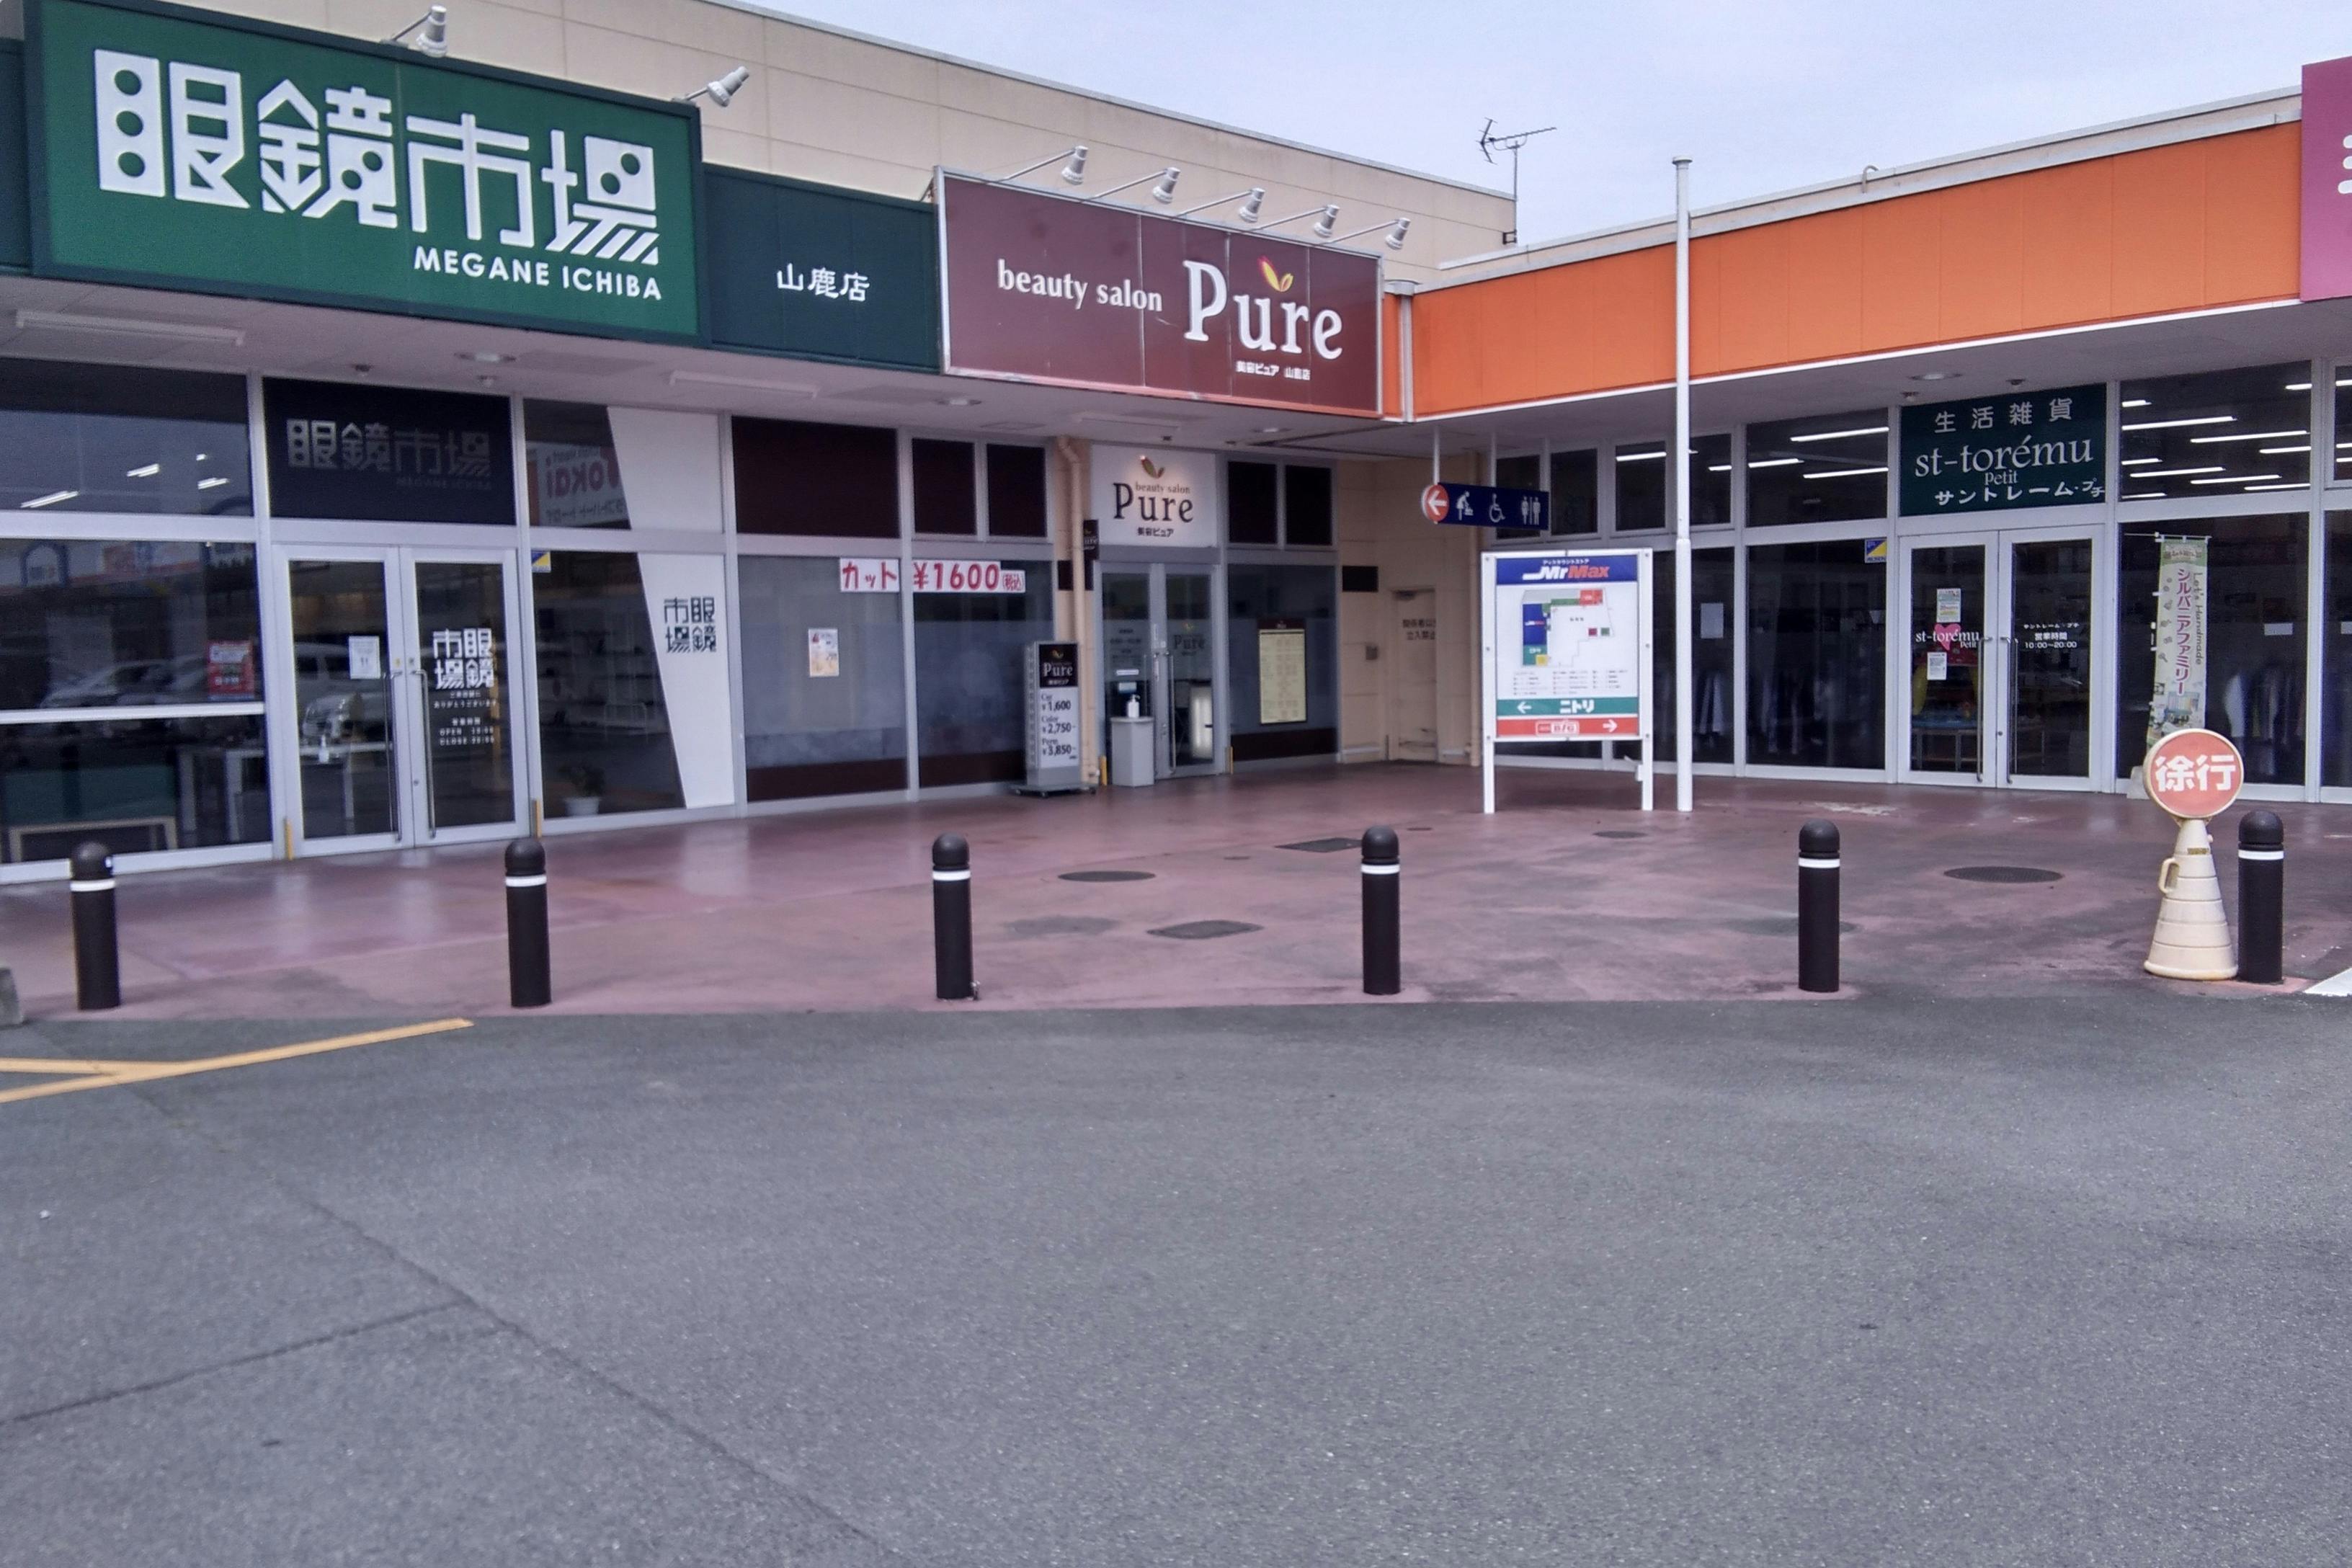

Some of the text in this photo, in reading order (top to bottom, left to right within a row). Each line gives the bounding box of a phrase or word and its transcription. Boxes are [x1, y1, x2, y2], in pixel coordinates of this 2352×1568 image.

[94, 49, 659, 264] 眼鏡市場
[414, 246, 661, 300] MEGANE ICHIBA
[777, 263, 870, 302] 山鹿店
[997, 259, 1162, 312] beauty salon
[1183, 260, 1342, 360] Pure
[1934, 398, 2072, 433] 生活雑貨
[1915, 435, 2094, 477] st-torému
[1113, 482, 1193, 522] Pure
[1136, 481, 1190, 494] beauty salon
[842, 561, 897, 589] カット
[913, 562, 999, 590] ¥1600
[1522, 564, 1610, 580] MrMax
[2176, 569, 2191, 694] シルバニアファミリー
[2195, 605, 2204, 665] Handmade
[1043, 662, 1073, 677] Pure
[1559, 699, 1595, 714] ニトリ
[2155, 754, 2236, 792] 徐行
